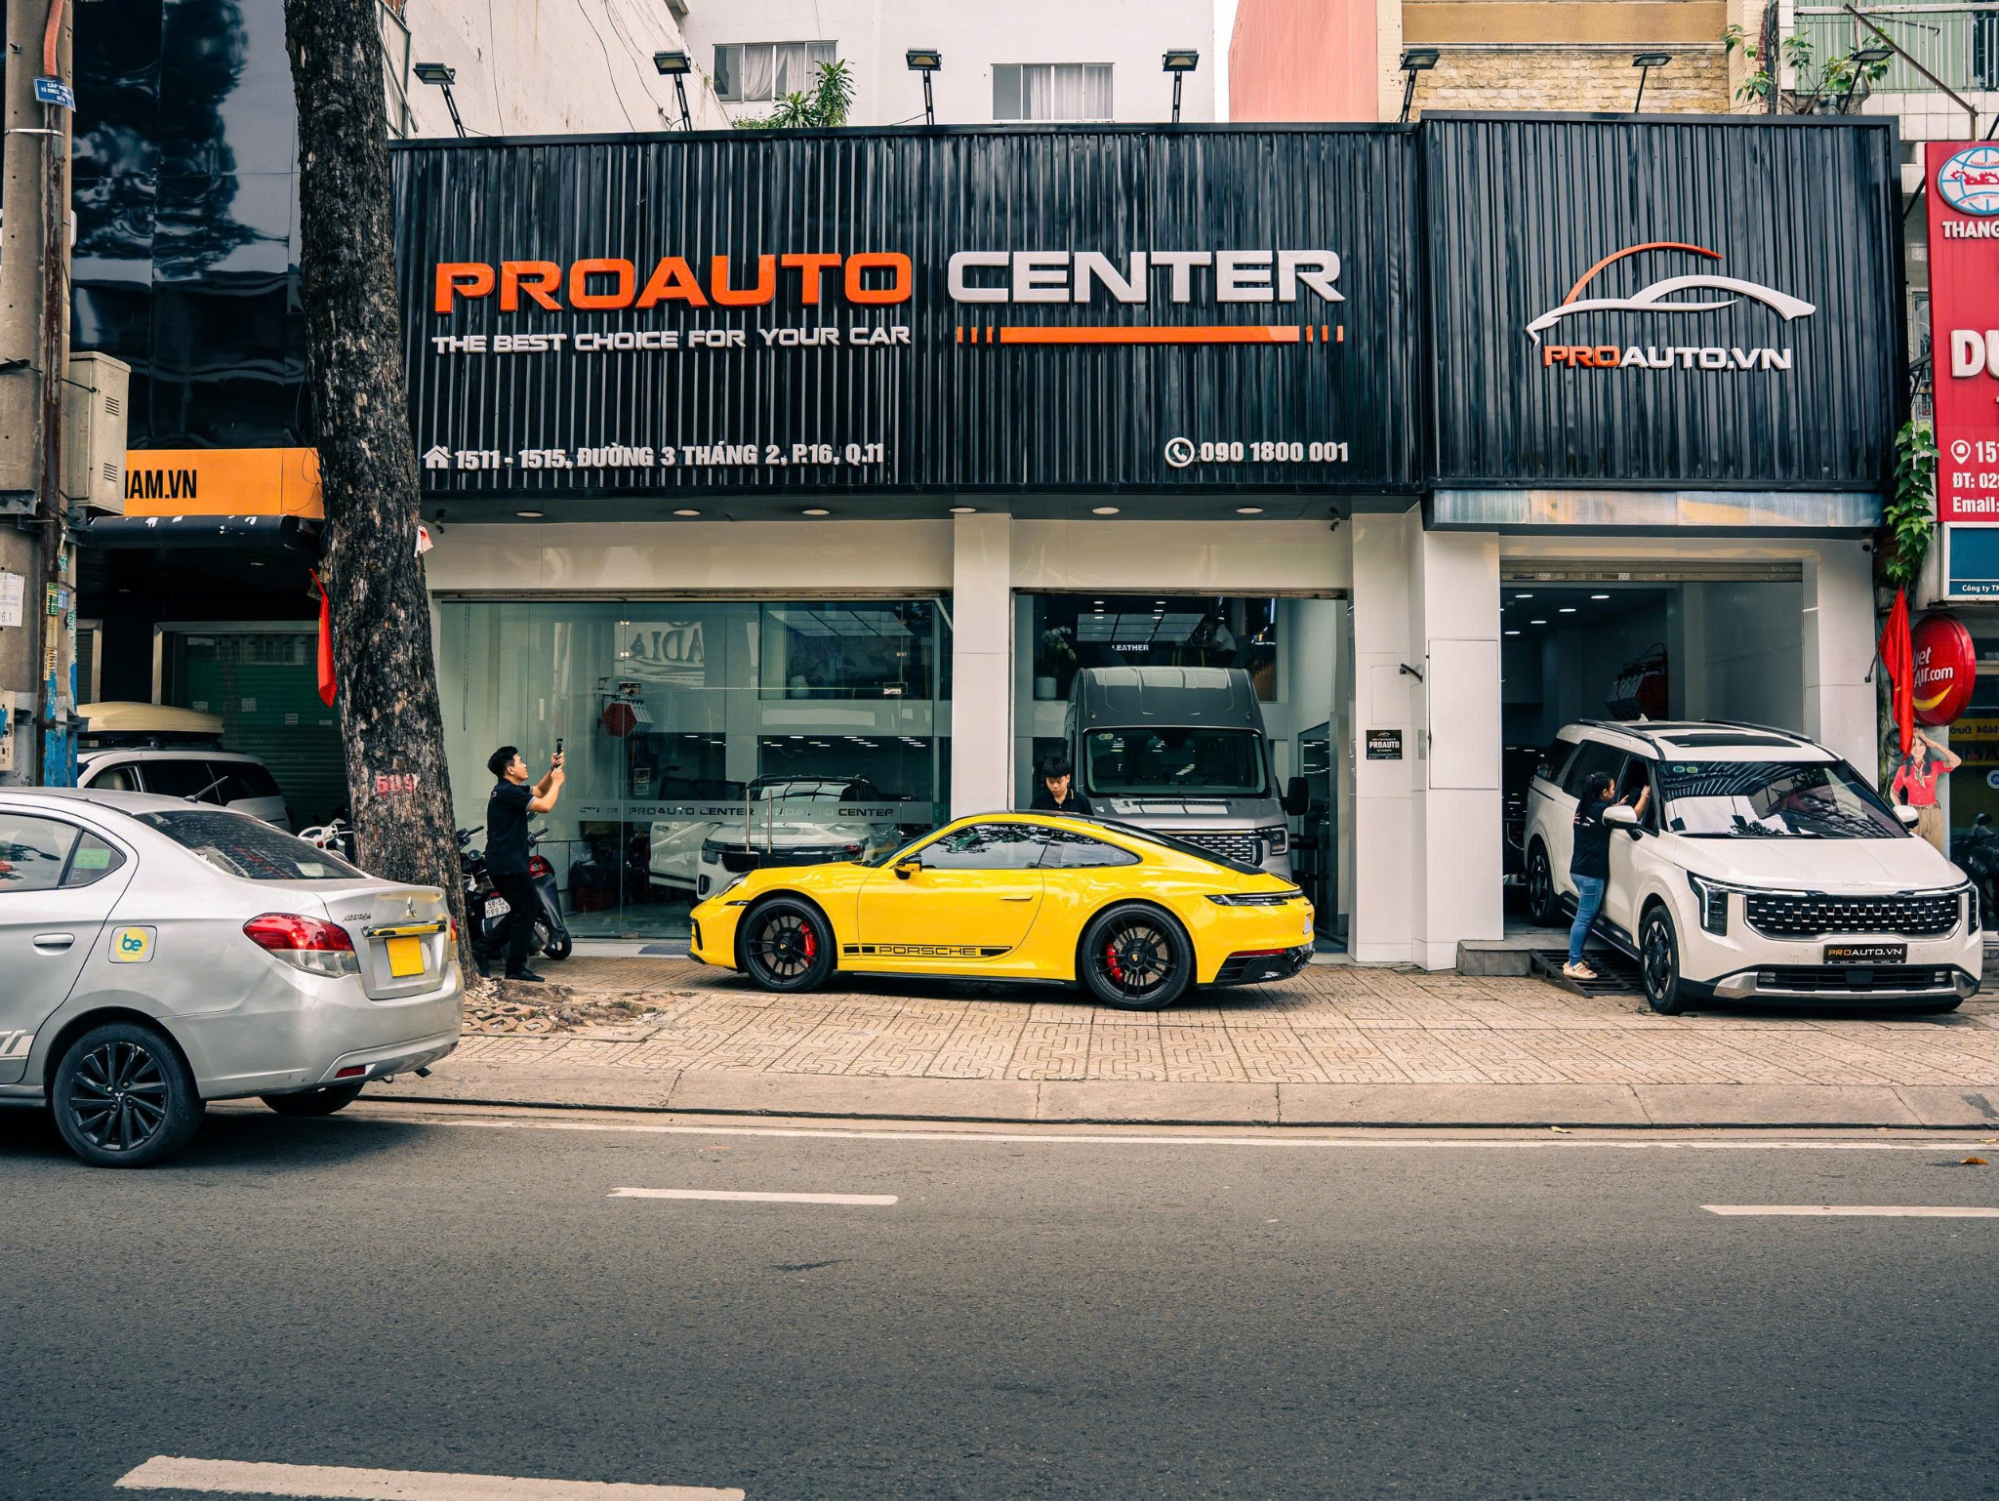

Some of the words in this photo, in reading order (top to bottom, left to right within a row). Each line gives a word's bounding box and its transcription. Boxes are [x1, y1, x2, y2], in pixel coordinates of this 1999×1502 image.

[435, 253, 912, 314] PROAUTO
[948, 250, 1346, 303] CENTER
[432, 335, 487, 354] THE
[493, 334, 567, 353] BEST
[574, 330, 678, 351] CHOICE
[688, 329, 746, 349] FOR
[759, 328, 840, 347] YOUR
[849, 326, 912, 346] CAR
[1543, 345, 1791, 370] PROAUTO.VN
[455, 450, 500, 469] 1511
[519, 449, 573, 470] 1515,
[577, 442, 654, 468] ĐƯỜNG
[660, 446, 676, 466] 3
[682, 441, 758, 466] THÁNG
[765, 445, 787, 466] 2,
[846, 443, 884, 466] Q.11
[1200, 441, 1244, 462] 090
[1250, 441, 1303, 462] 1800
[1309, 441, 1348, 462] 001
[1975, 441, 1999, 463] 15
[1952, 472, 1975, 489] ĐT:
[1979, 472, 1999, 489] 02
[1953, 496, 1999, 513] Email:
[121, 932, 143, 952] be
[878, 946, 977, 956] PORSCHE
[1828, 948, 1902, 956] PROAUTO.VN
